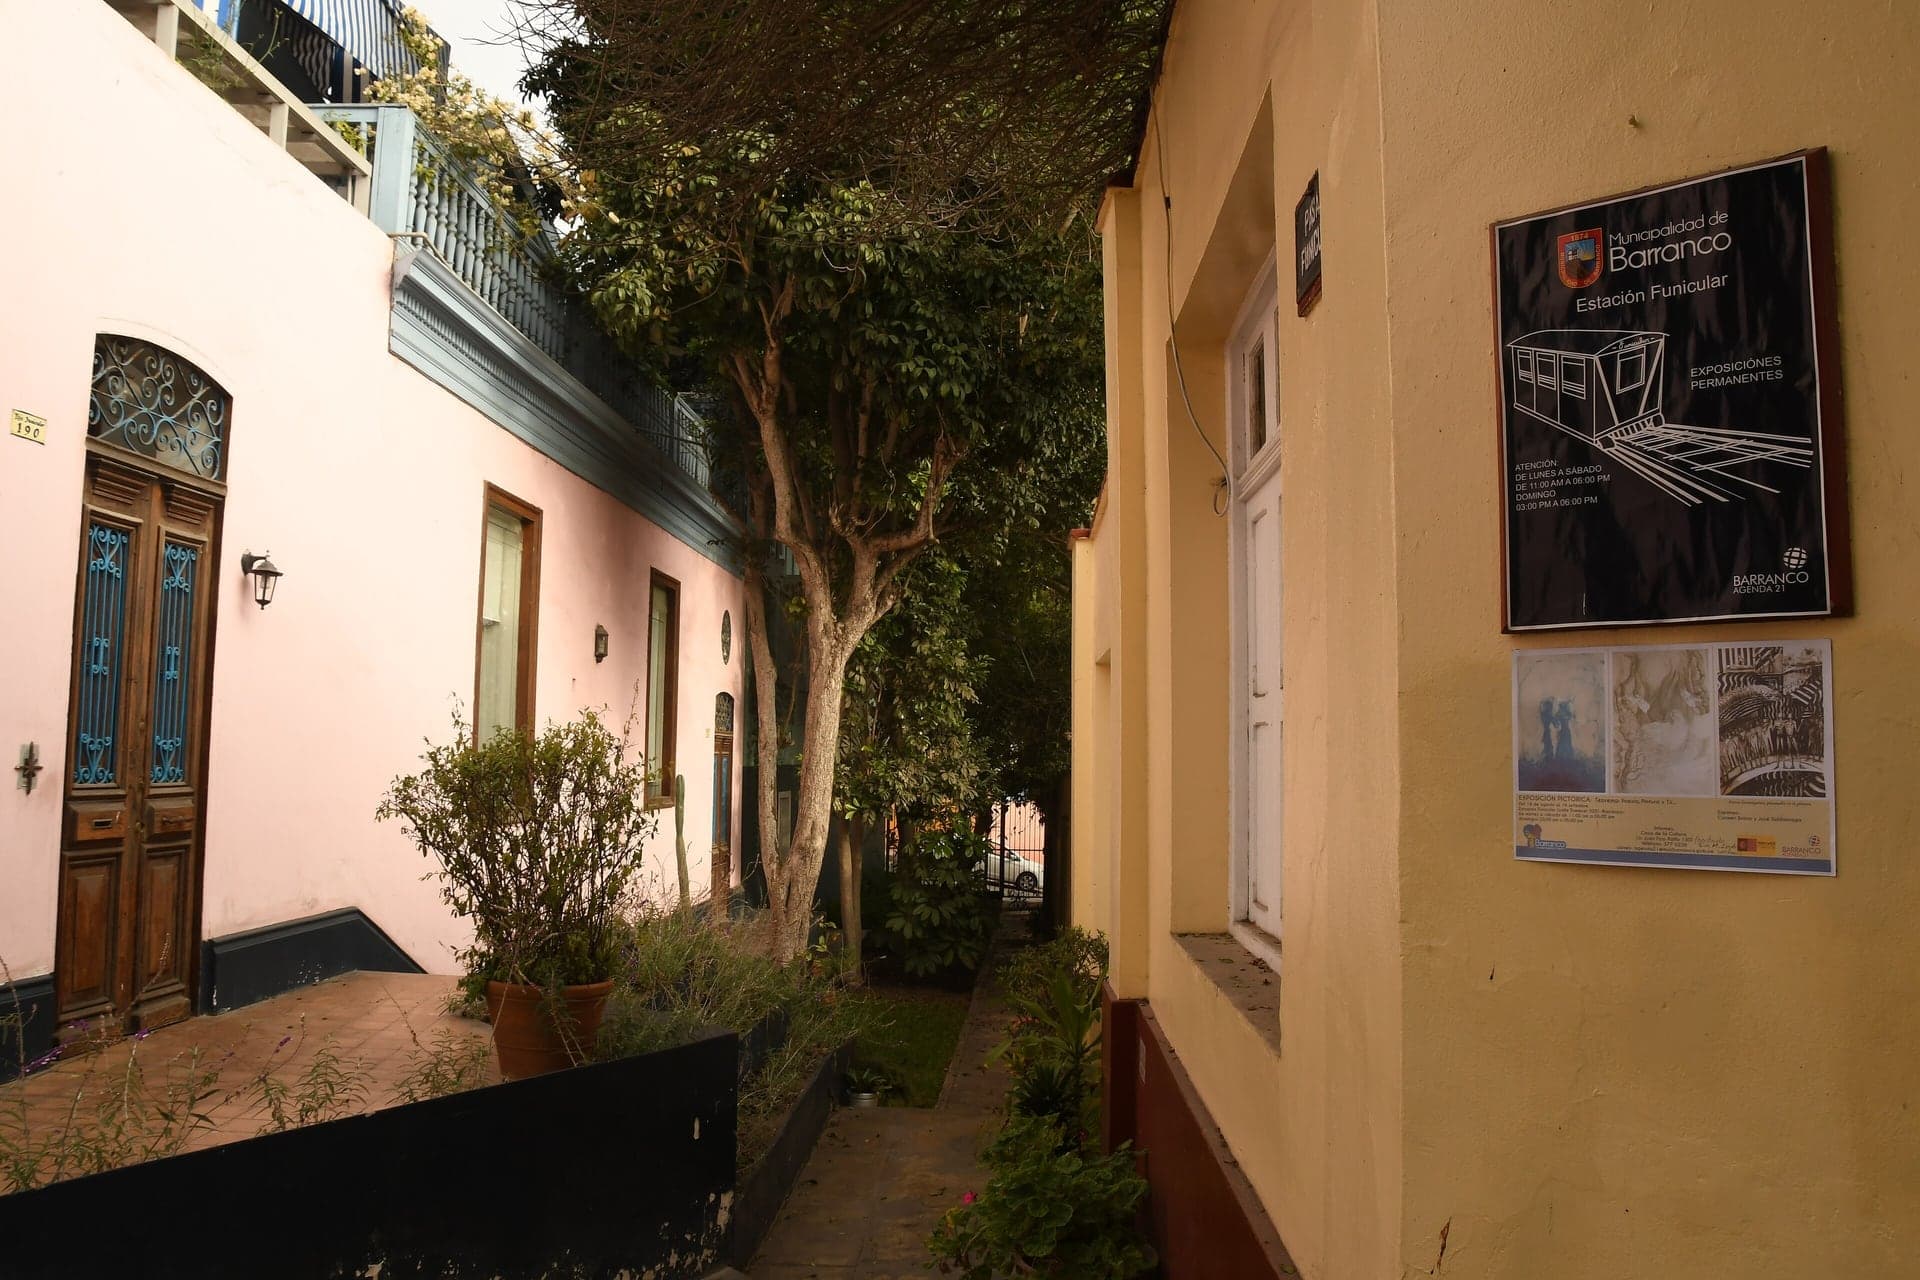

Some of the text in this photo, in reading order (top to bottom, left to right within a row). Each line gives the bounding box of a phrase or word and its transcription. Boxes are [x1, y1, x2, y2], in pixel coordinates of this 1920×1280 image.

[1609, 210, 1728, 247] Municipalidad de
[1610, 232, 1732, 272] Barranco
[1576, 274, 1728, 313] Estación Funicular
[1690, 369, 1784, 391] PERMANENTES
[17, 422, 40, 438] 190
[1515, 473, 1527, 481] DE
[1529, 469, 1557, 480] LUNES
[1557, 468, 1564, 477] A
[1515, 483, 1527, 492] DE
[1550, 479, 1564, 488] AM
[1565, 478, 1572, 486] A
[1597, 474, 1611, 483] PM
[1515, 489, 1557, 502] DOMINGO
[1539, 500, 1551, 509] PM
[1552, 499, 1559, 508] A
[1584, 496, 1598, 505] PM
[1733, 571, 1809, 587] BARRANCO
[1733, 584, 1785, 594] AGENDA 21
